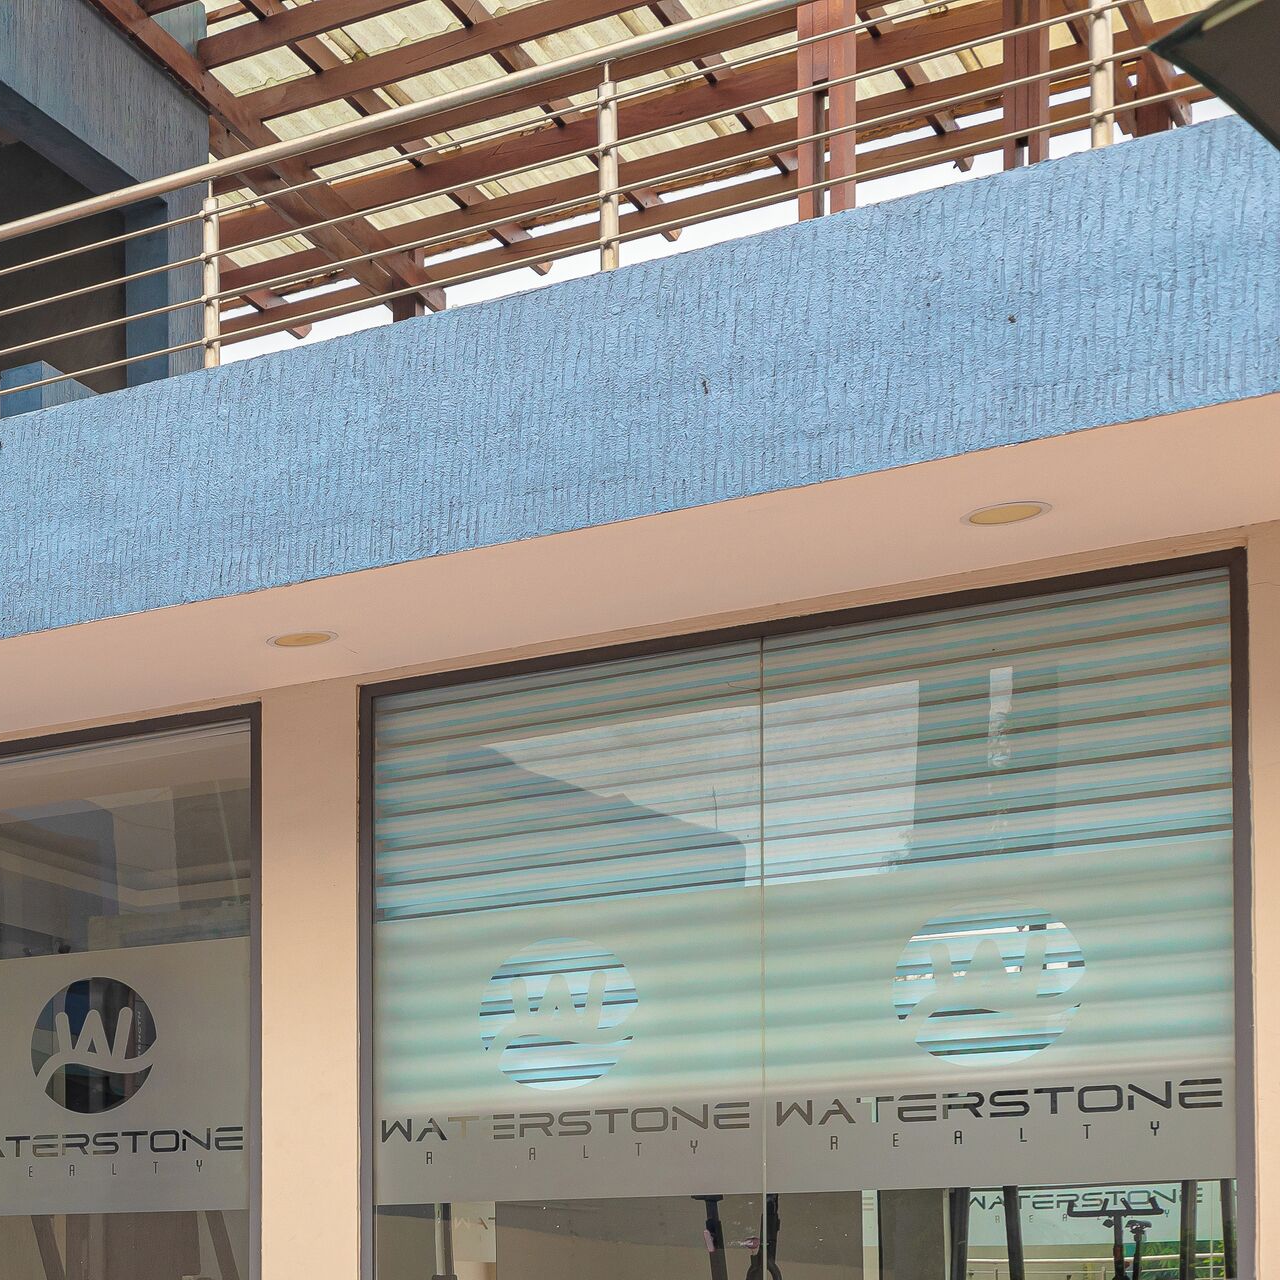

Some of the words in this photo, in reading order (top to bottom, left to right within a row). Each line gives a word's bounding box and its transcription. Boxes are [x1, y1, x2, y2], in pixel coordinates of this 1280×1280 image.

[776, 1078, 1223, 1127] WATERSTONE
[381, 1101, 750, 1142] WATERSTONE
[830, 1120, 1160, 1150] REALTY
[426, 1140, 698, 1165] RALTY
